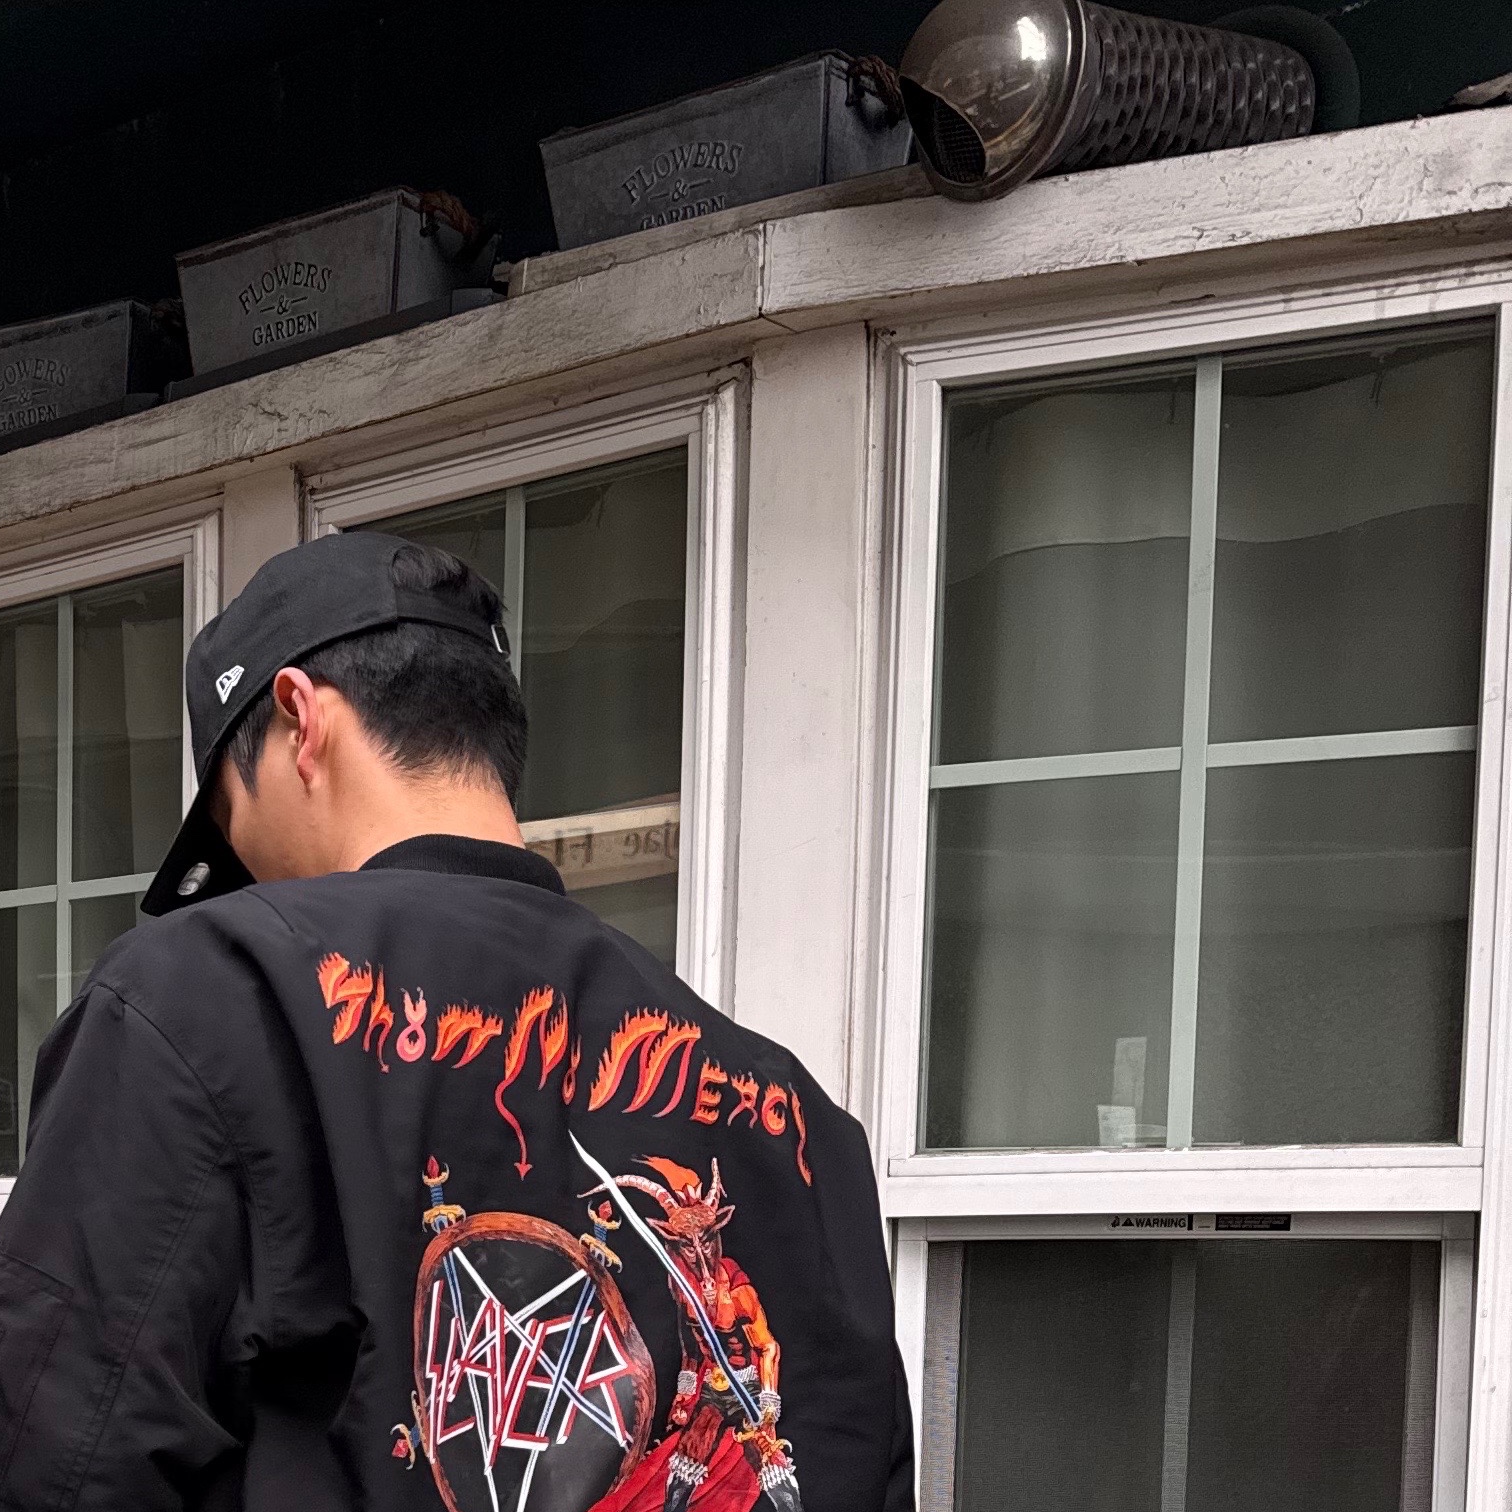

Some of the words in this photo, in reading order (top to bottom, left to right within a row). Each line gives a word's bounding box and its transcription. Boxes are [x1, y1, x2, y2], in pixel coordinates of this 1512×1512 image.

[621, 141, 744, 206] FLOWERS
[672, 180, 687, 202] &
[239, 262, 332, 315] FLOWERS
[277, 294, 290, 315] &
[252, 311, 319, 346] GARDEN
[1135, 1217, 1187, 1229] WARNING
